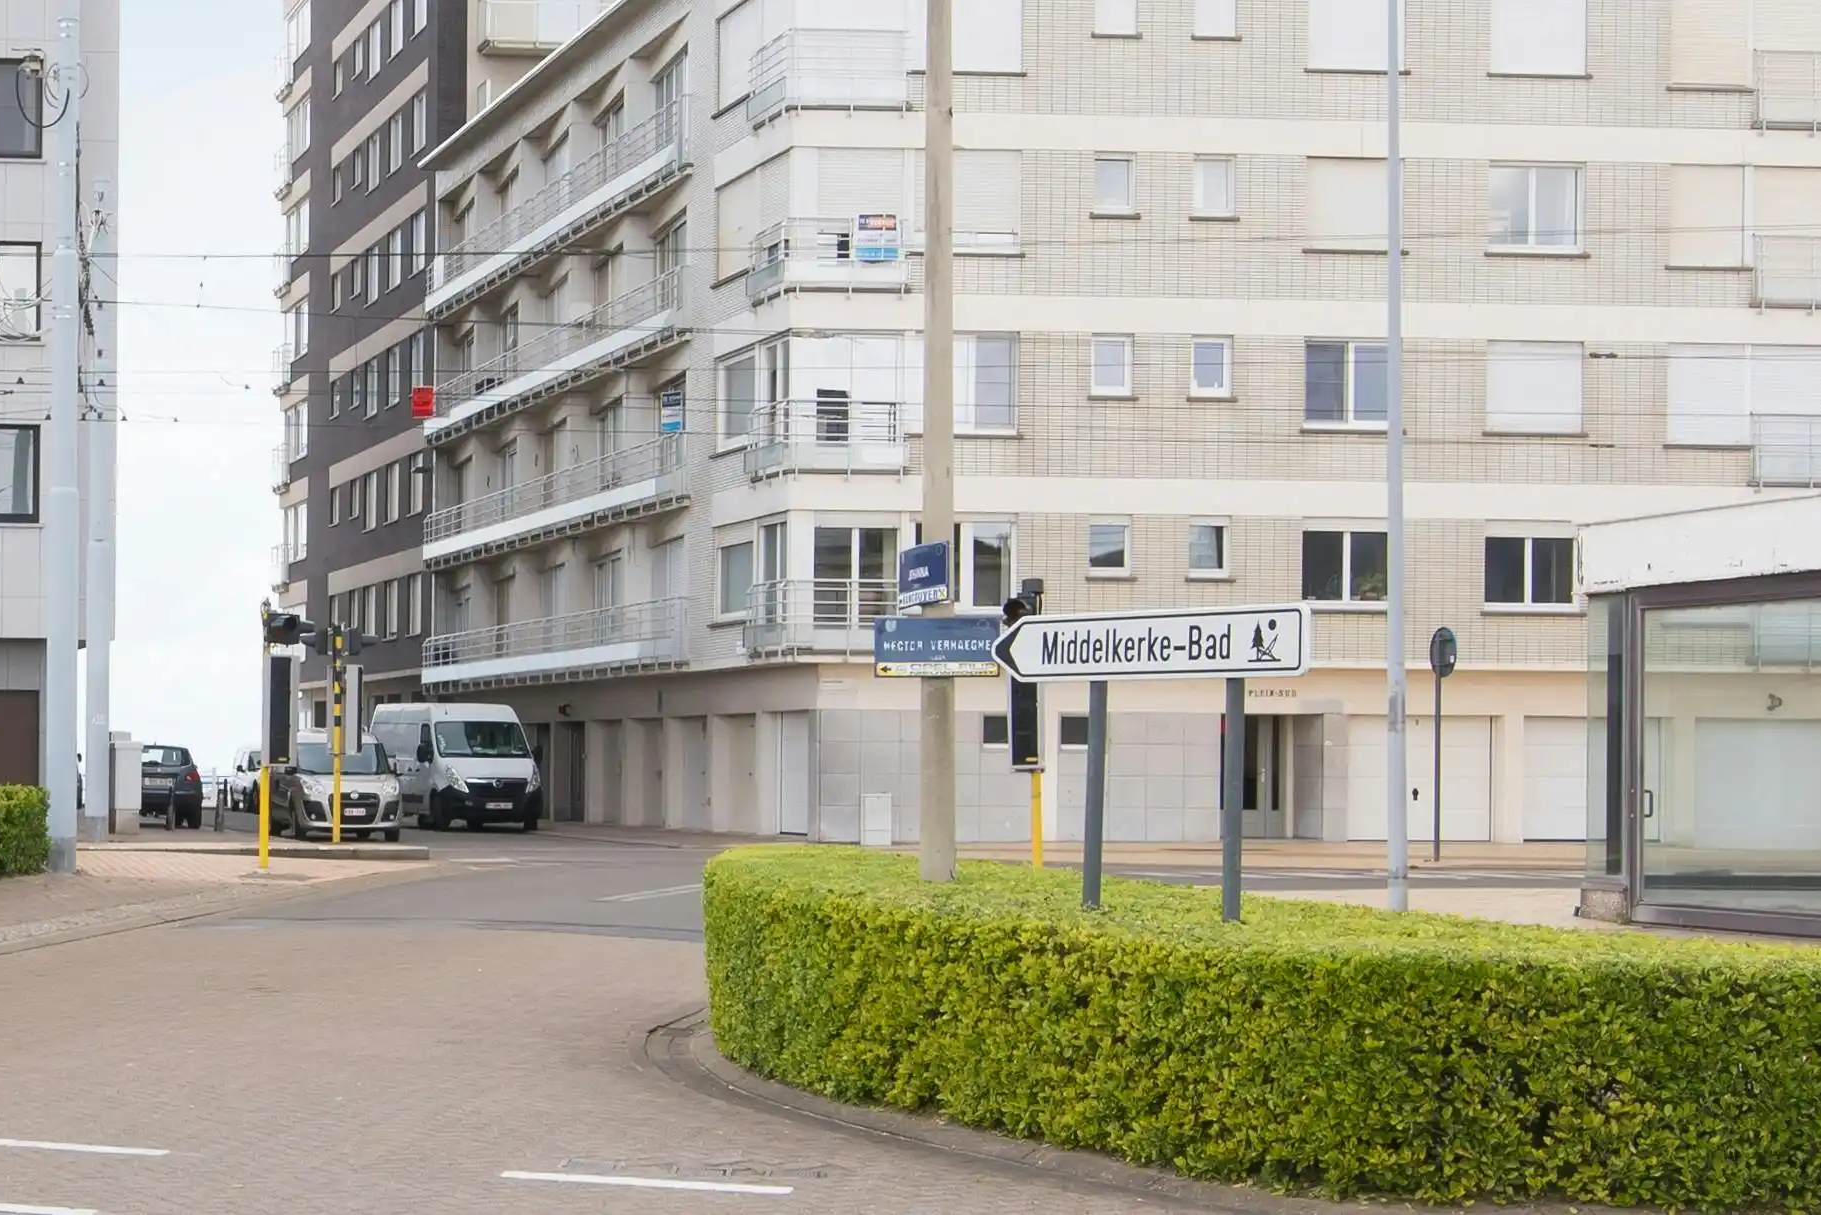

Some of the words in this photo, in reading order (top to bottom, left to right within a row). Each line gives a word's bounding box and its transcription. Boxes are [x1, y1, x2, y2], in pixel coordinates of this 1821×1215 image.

[883, 640, 923, 651] HECTOR
[930, 639, 992, 651] VERHAEGHE
[1041, 623, 1232, 665] Middelkerke-Bad
